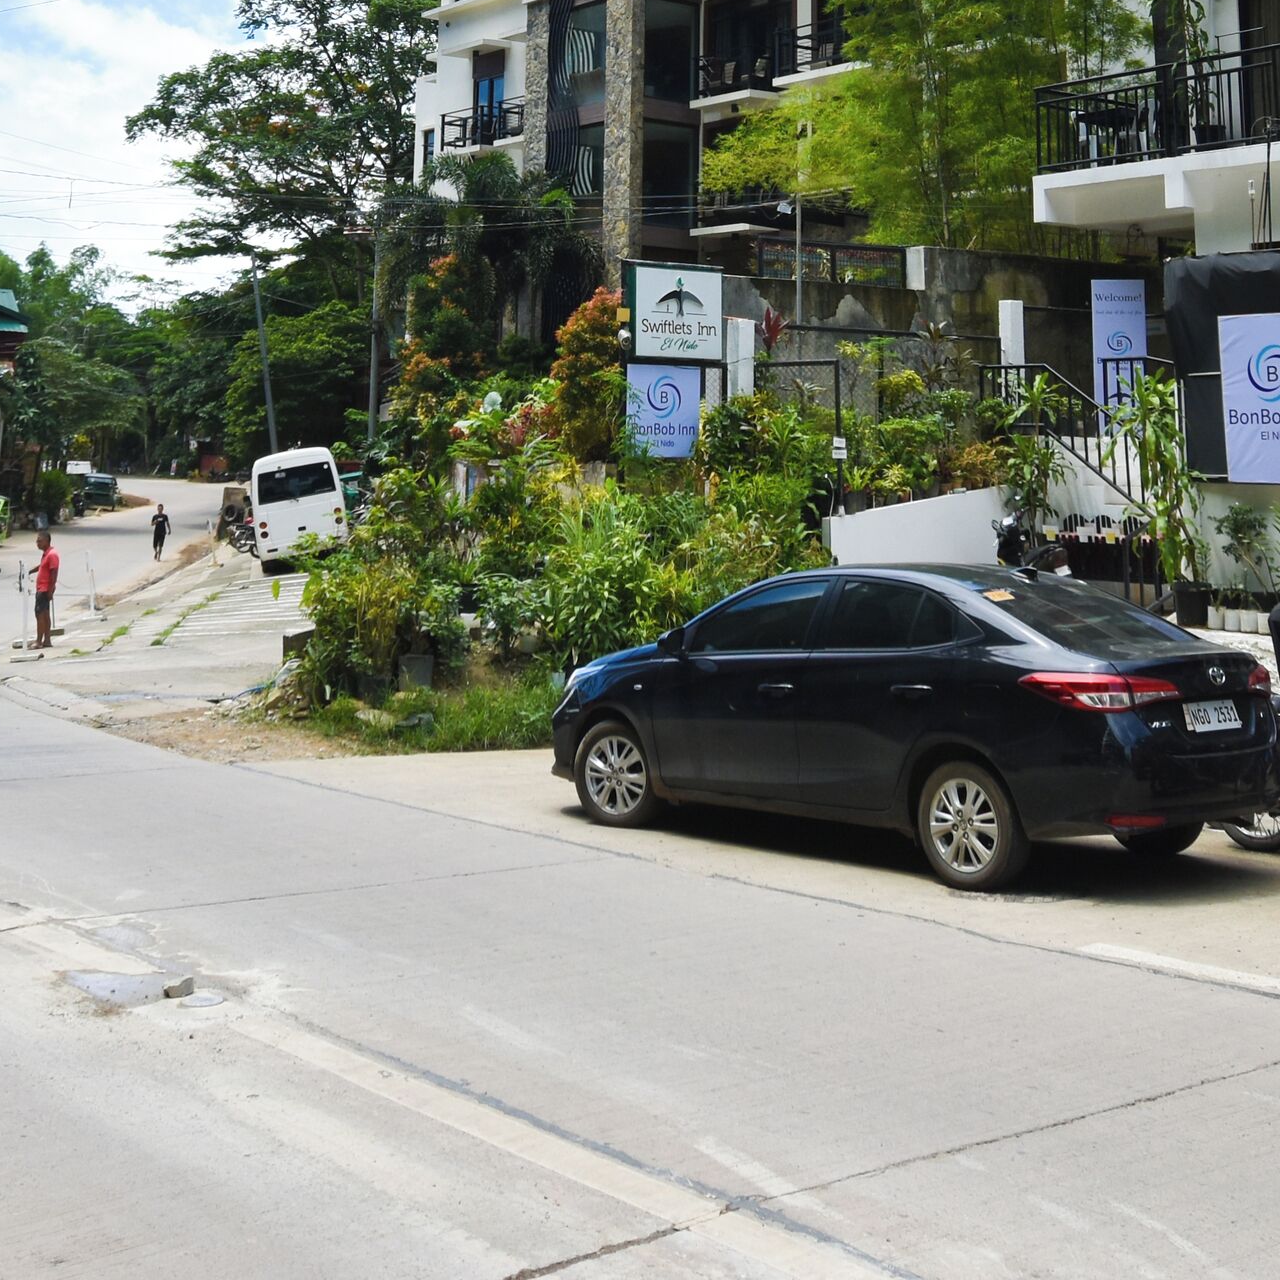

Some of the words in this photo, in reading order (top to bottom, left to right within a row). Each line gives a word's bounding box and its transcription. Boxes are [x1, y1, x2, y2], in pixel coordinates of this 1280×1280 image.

[1095, 293, 1142, 302] Welcome!
[641, 319, 692, 335] Swiftlets
[697, 322, 717, 336] Inn
[660, 338, 671, 351] El
[673, 339, 699, 351] Nido
[1267, 366, 1279, 382] B
[660, 391, 668, 404] B
[678, 423, 695, 436] Inn
[1261, 431, 1269, 440] El
[660, 440, 675, 448] Nido
[1214, 706, 1239, 724] 2531
